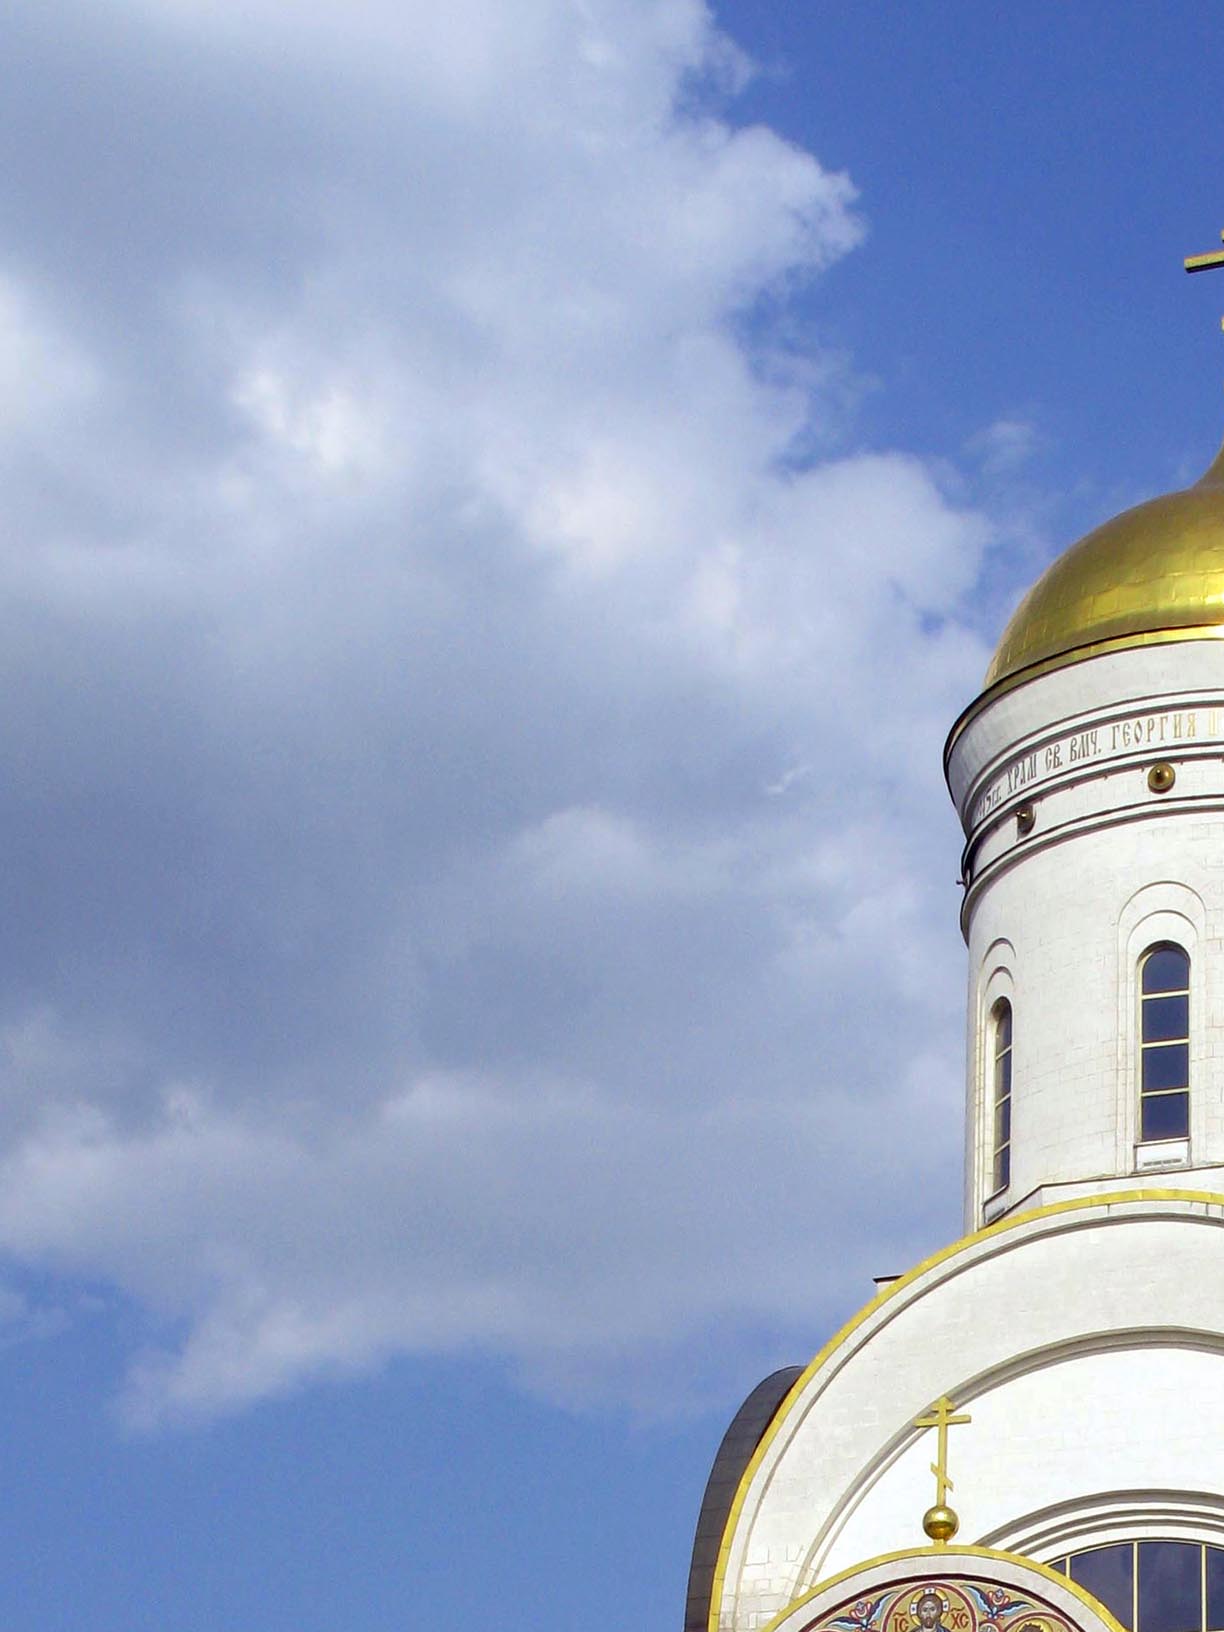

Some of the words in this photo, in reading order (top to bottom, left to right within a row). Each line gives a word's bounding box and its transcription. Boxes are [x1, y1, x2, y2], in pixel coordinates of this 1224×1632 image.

[1006, 754, 1038, 796] ХРАМ
[1044, 743, 1063, 772] СВ.
[1069, 729, 1101, 763] ВМЧ.
[1111, 712, 1196, 750] ГЕОРГИЯ
